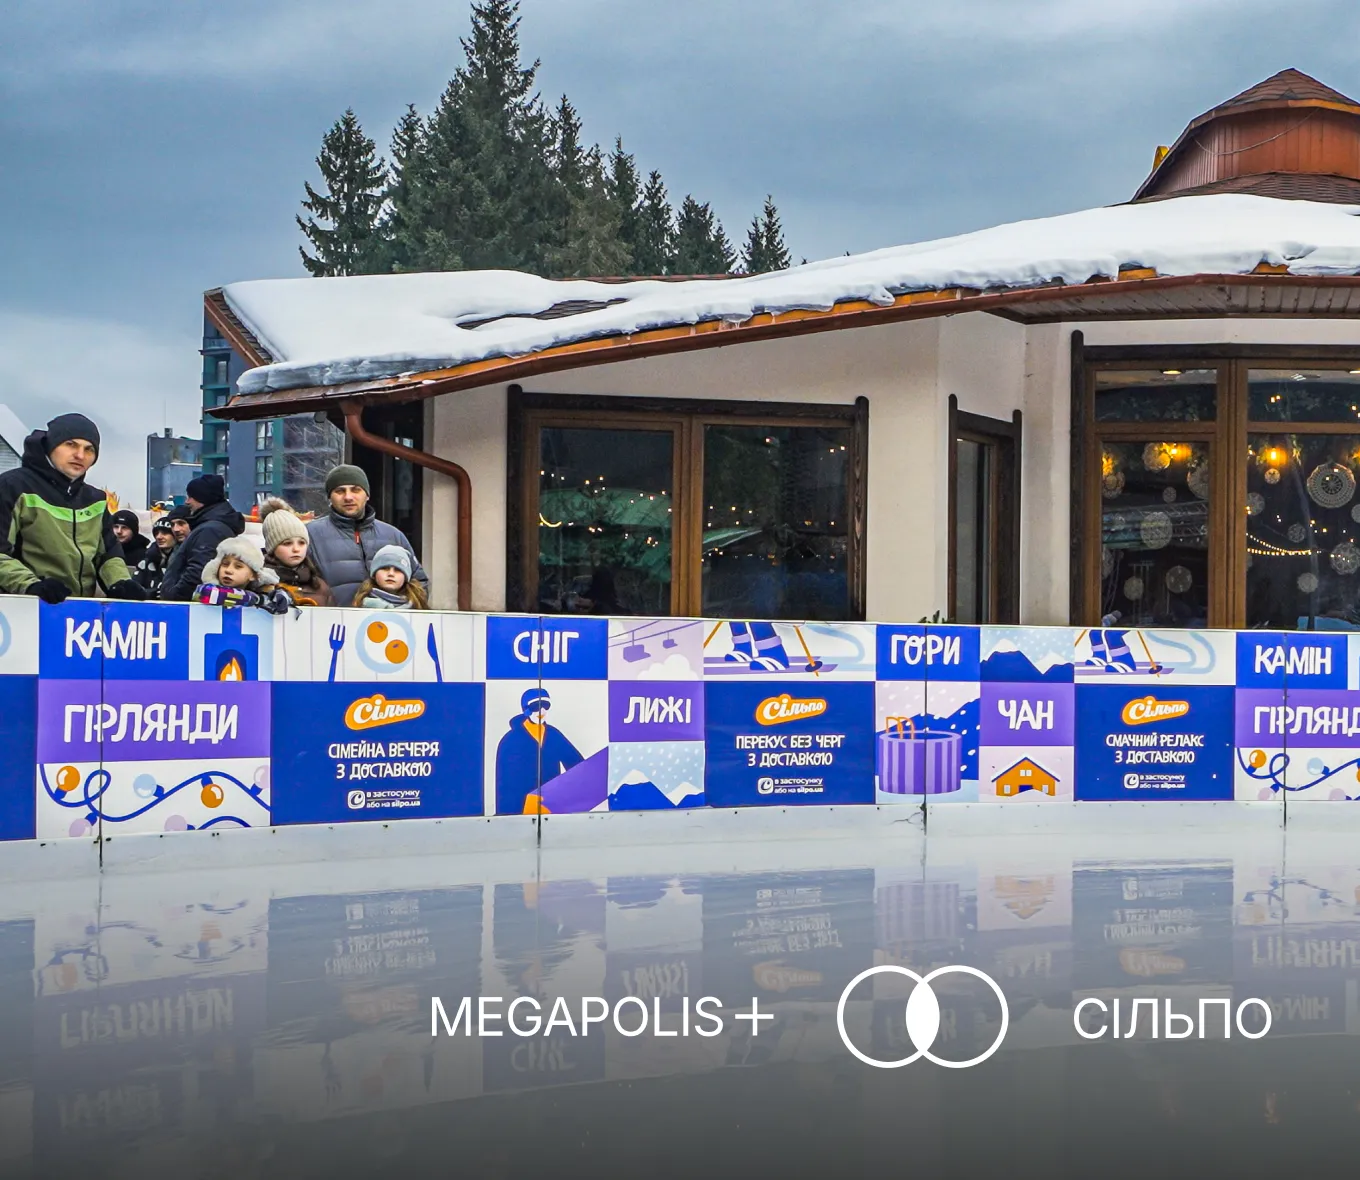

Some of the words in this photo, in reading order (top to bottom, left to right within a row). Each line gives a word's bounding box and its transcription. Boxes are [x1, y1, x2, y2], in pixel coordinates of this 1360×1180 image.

[66, 618, 166, 660] КАМІН
[514, 631, 579, 663] СНІГ
[891, 635, 960, 664] ГОРИ
[1255, 645, 1331, 674] КАМІН
[354, 700, 421, 723] Сільпо
[624, 696, 691, 723] ЛИЖІ
[763, 699, 822, 719] Сільпо
[998, 700, 1053, 730] ЧАН
[1130, 701, 1188, 719] Сільпо
[64, 704, 238, 744] ГІРЛЯНДИ
[329, 740, 385, 758] СІМЕЙНА
[389, 742, 439, 757] ВЕЧЕРЯ
[737, 736, 787, 748] ПЕРЕКУС
[791, 735, 812, 748] БЕЗ
[816, 735, 845, 747] ЧЕРГ
[1106, 733, 1157, 747] СМАЧНИЙ
[1160, 735, 1204, 746] РЕЛАКС
[749, 753, 755, 766] З
[760, 752, 832, 767] ДОСТАВКОЮ
[1116, 751, 1122, 762] З
[1126, 751, 1194, 764] ДОСТАВКОЮ
[337, 764, 345, 778] З
[350, 762, 431, 779] ДОСТАВКОЮ
